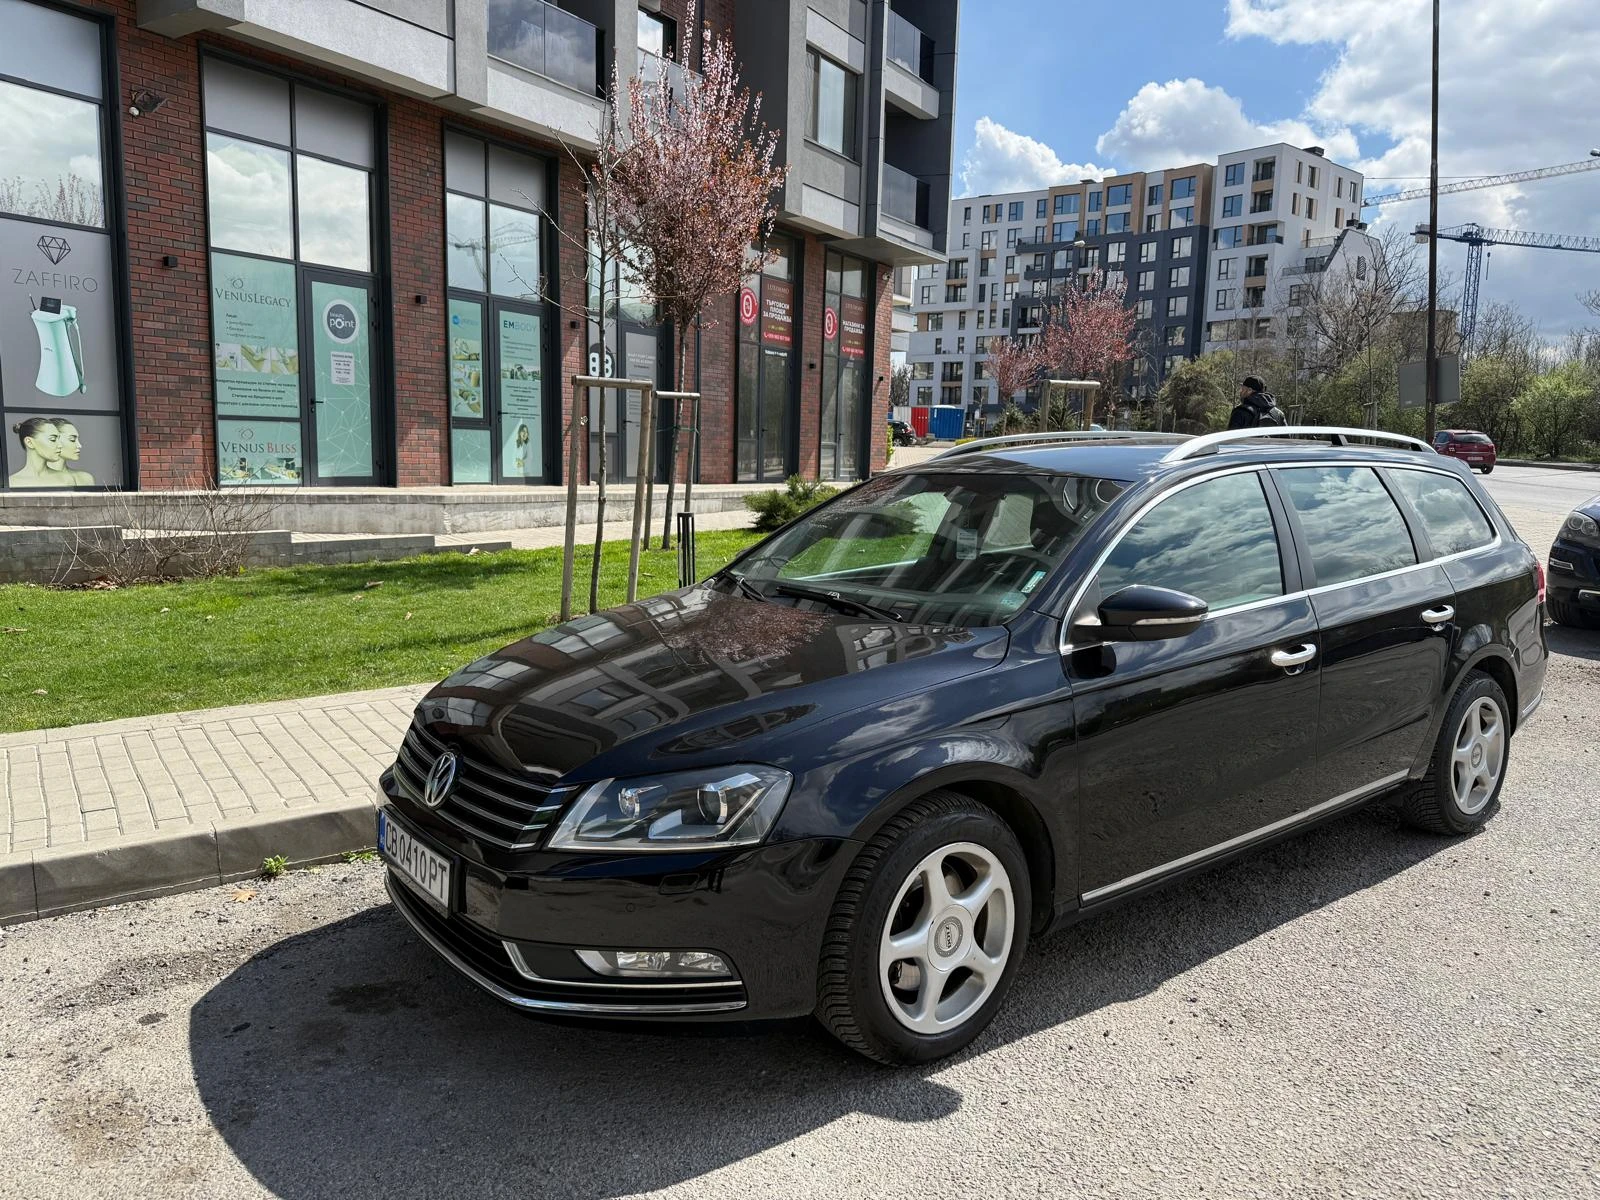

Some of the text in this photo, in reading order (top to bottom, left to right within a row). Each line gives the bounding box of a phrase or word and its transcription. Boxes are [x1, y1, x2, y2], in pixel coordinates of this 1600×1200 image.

[12, 268, 98, 293] ZAFFIRO
[221, 441, 296, 454] VENUS BLISS
